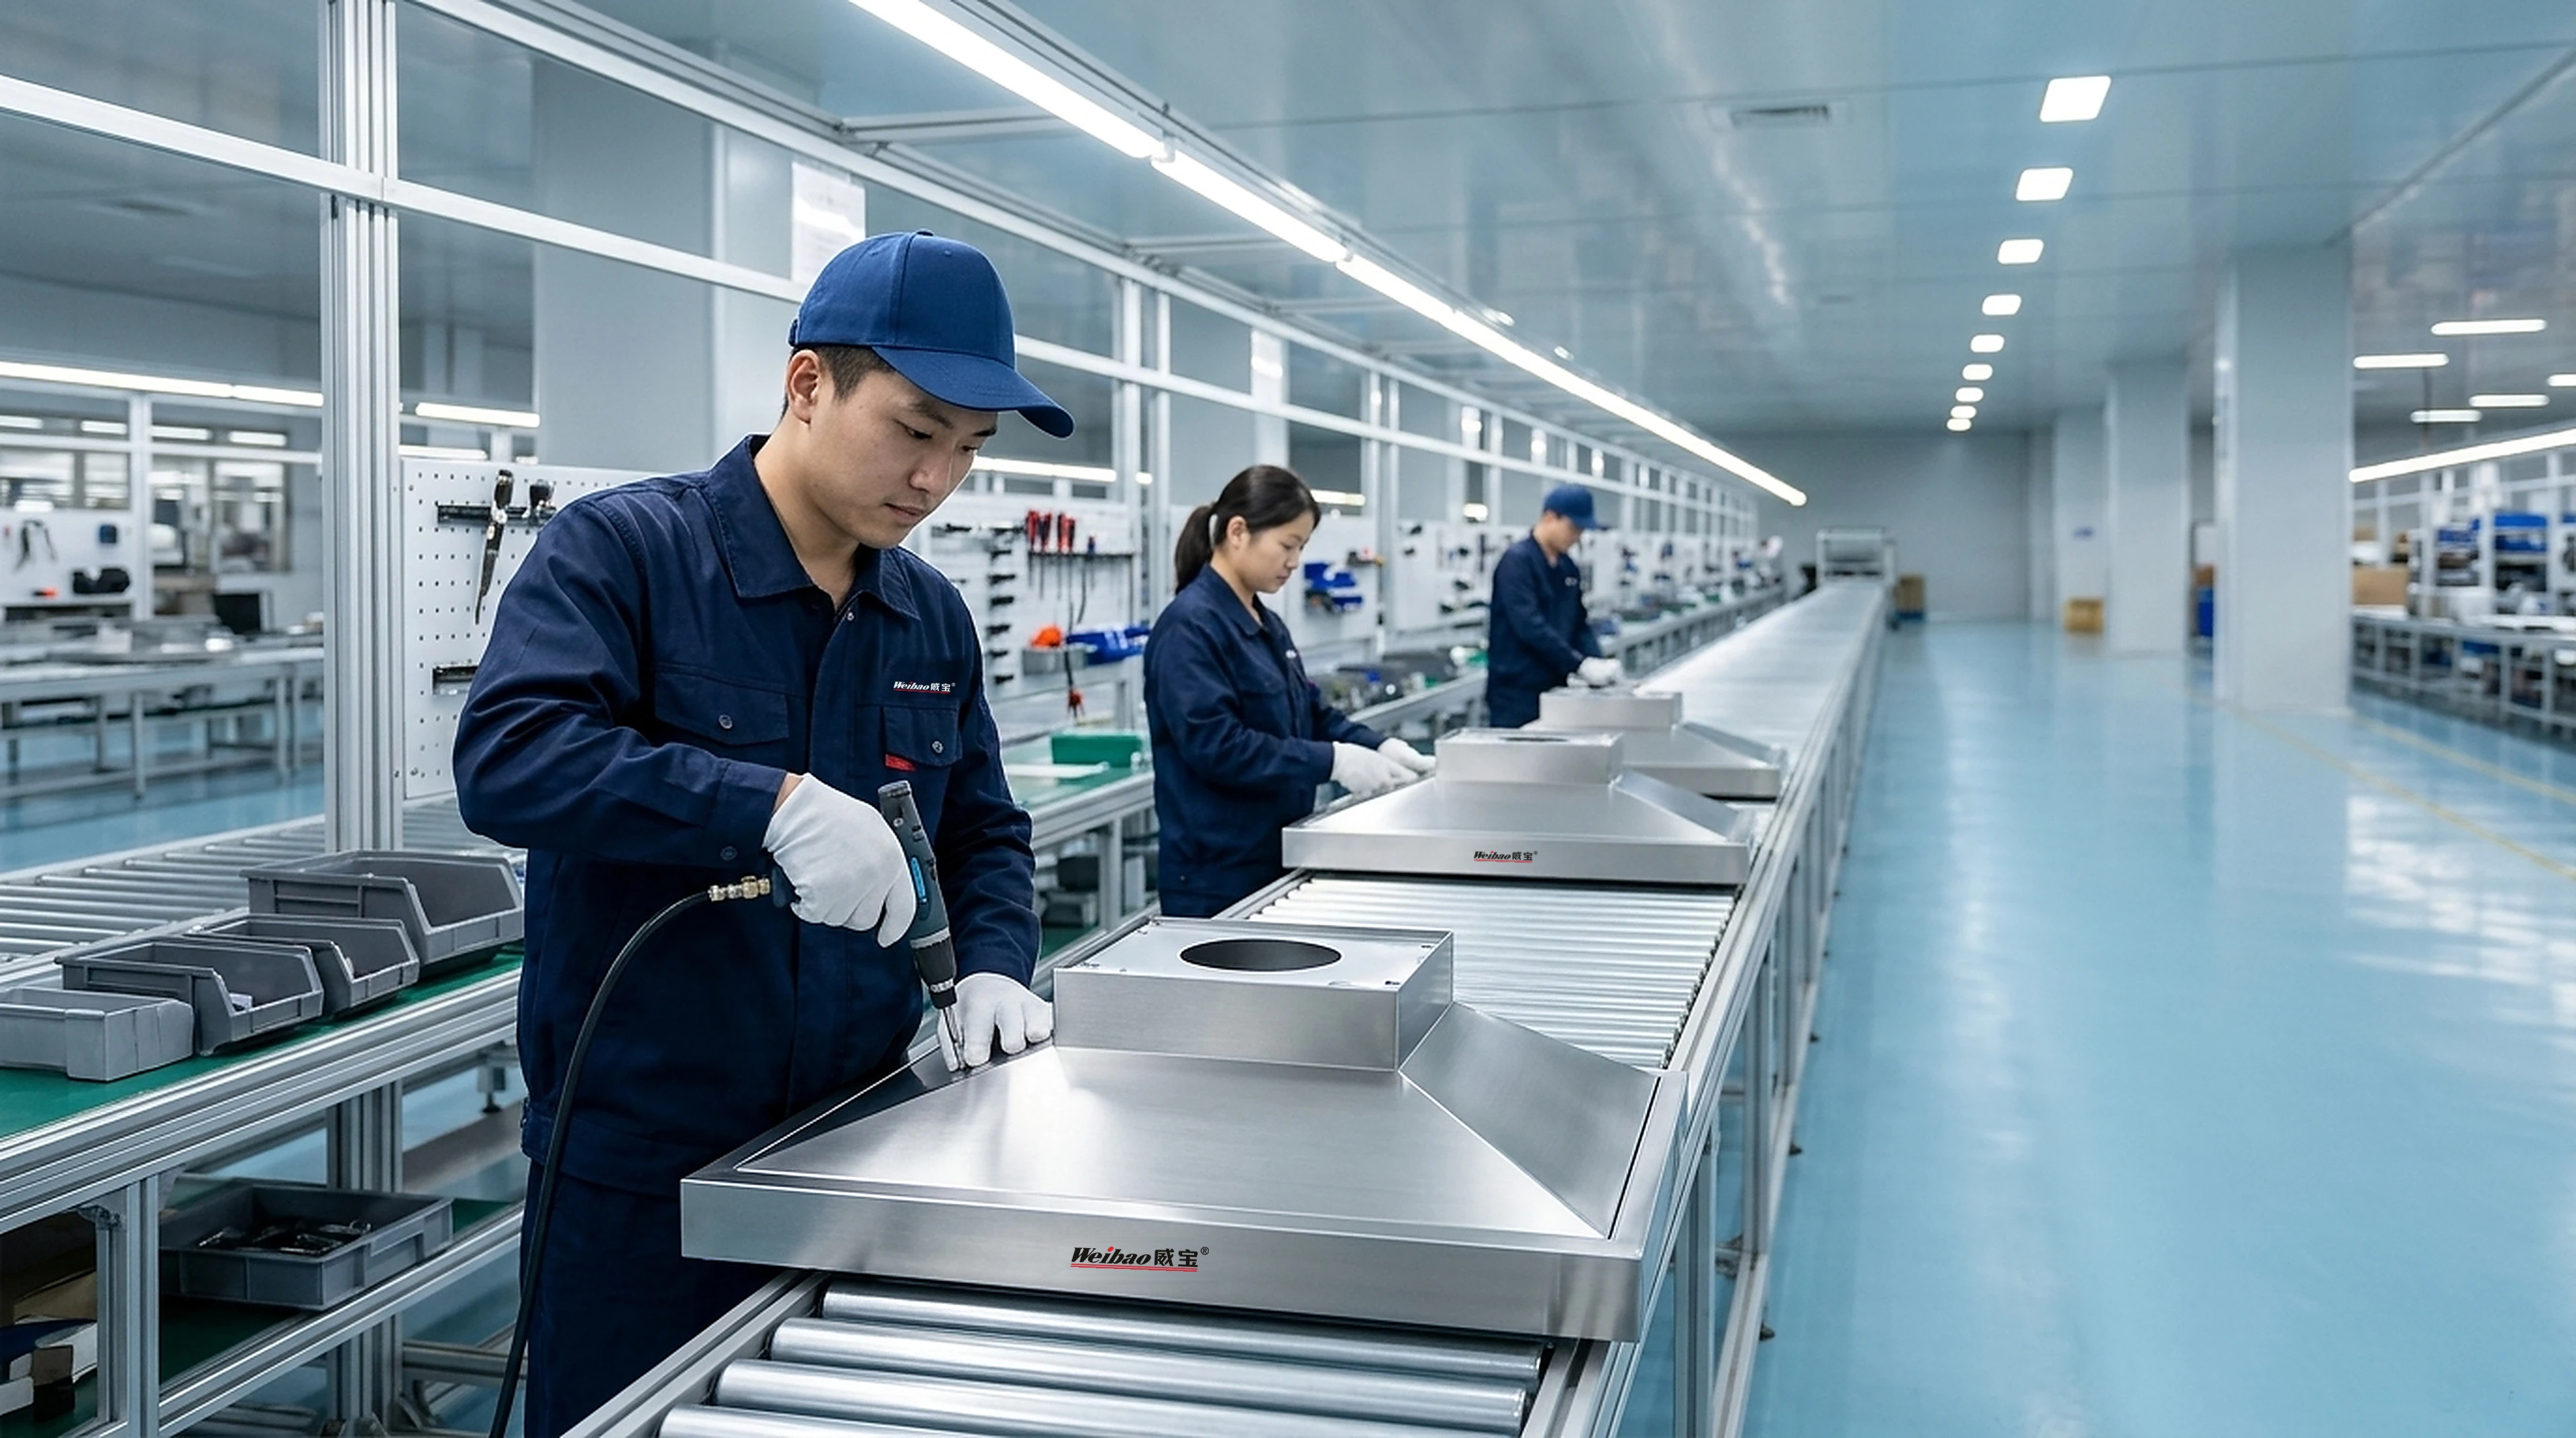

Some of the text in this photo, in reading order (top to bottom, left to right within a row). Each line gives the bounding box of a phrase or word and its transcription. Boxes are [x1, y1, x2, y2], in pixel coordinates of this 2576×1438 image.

[893, 681, 930, 690] Weibao
[1473, 850, 1511, 860] Weibao
[1071, 1246, 1151, 1265] Weibao
